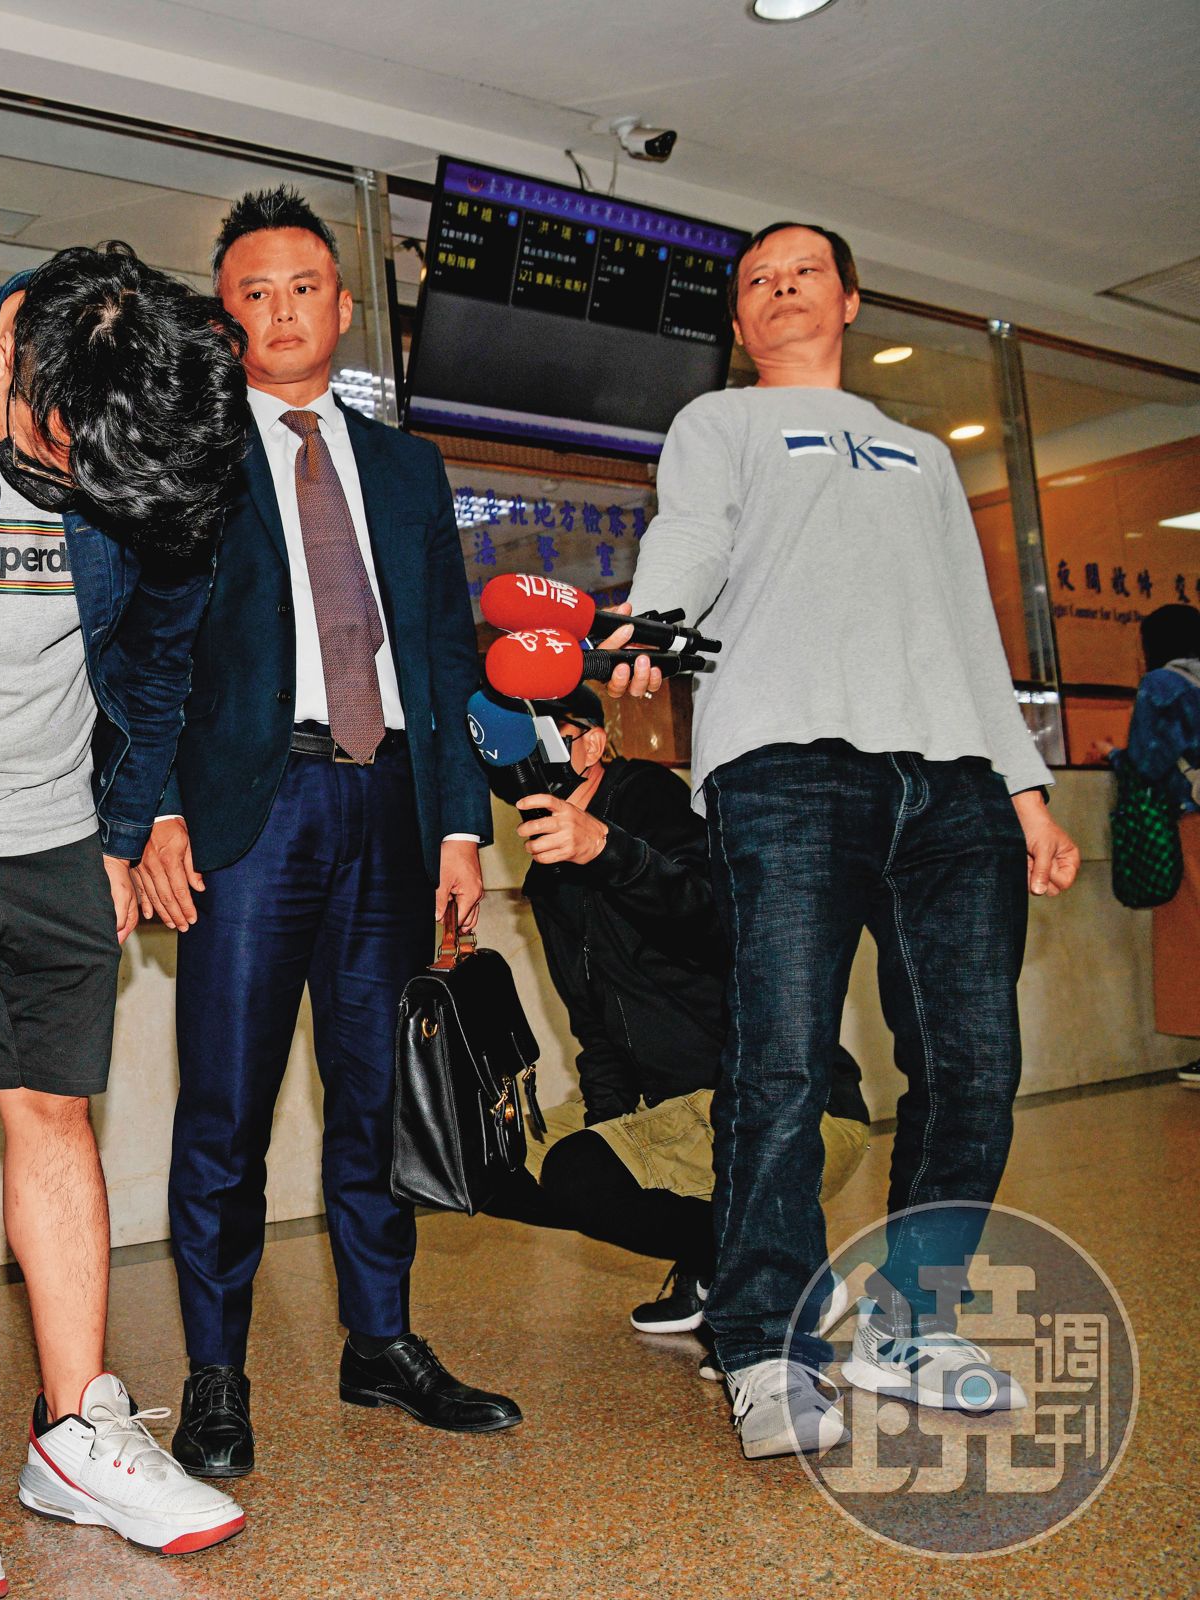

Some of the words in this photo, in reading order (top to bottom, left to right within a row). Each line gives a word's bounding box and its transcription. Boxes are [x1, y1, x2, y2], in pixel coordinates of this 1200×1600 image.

[828, 430, 892, 472] CK
[474, 531, 615, 578] 法警室
